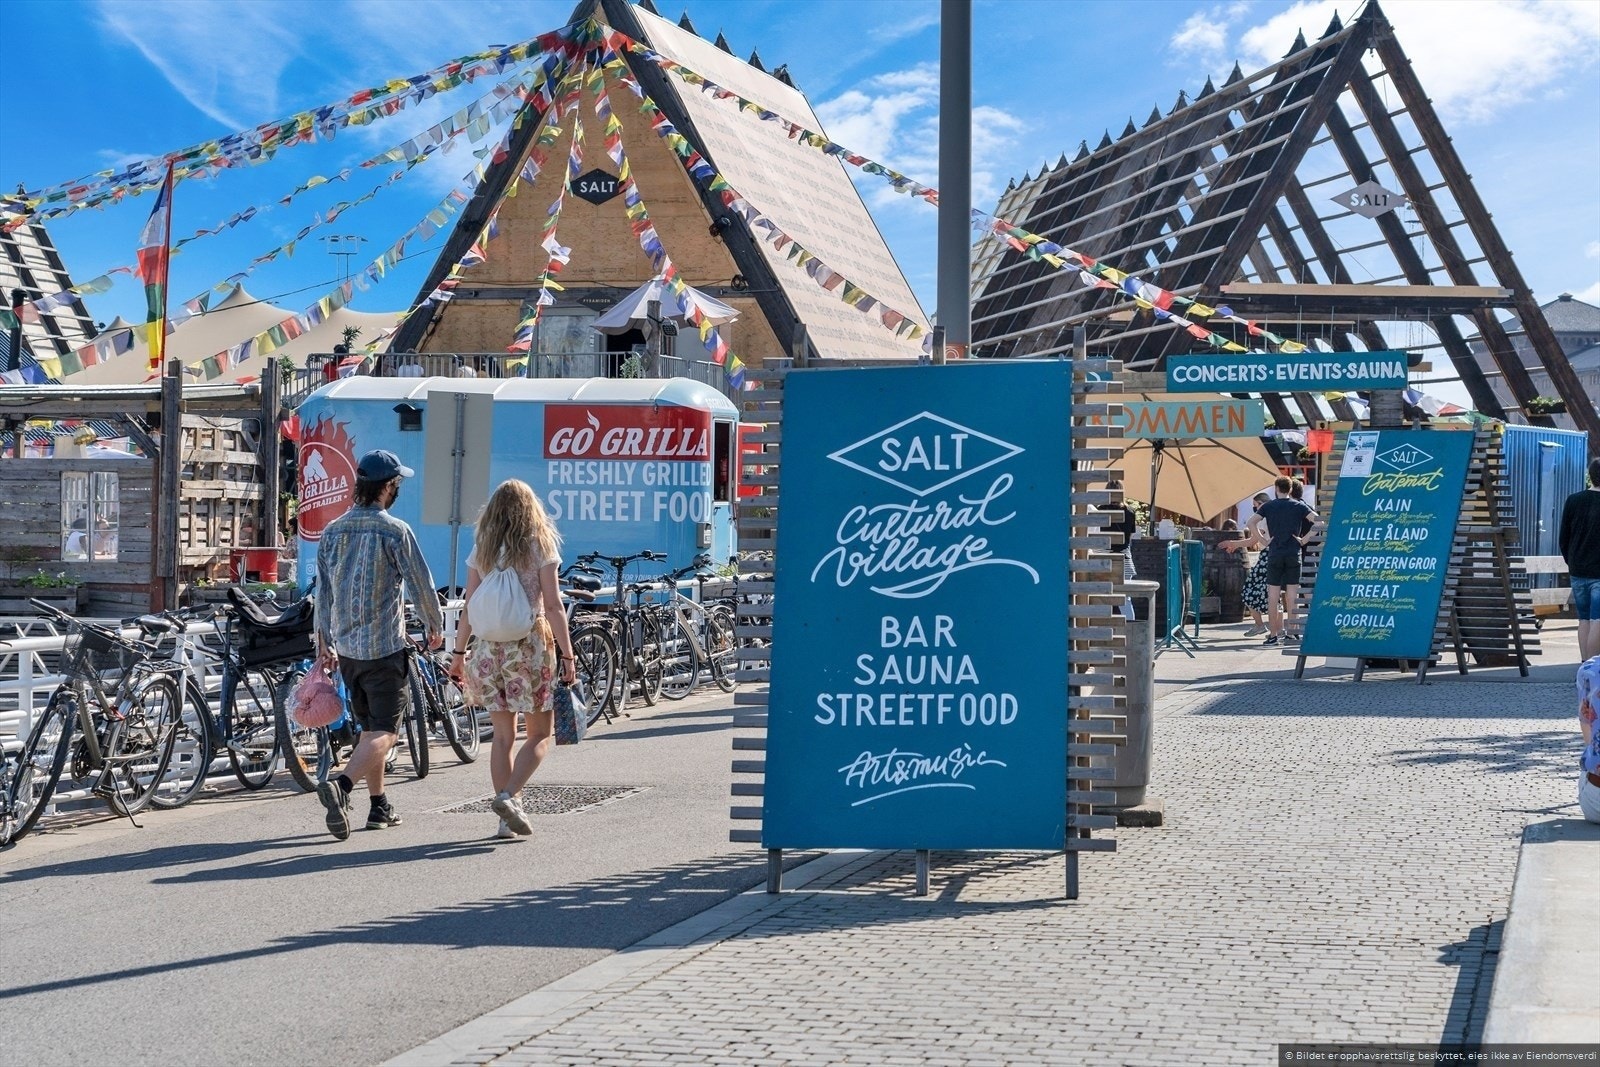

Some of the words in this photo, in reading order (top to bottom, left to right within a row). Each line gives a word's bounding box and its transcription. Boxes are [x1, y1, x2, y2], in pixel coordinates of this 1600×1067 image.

[580, 180, 615, 193] SALT
[1350, 193, 1389, 207] SALT
[549, 426, 596, 456] GO
[600, 426, 708, 457] GRILLA
[878, 433, 968, 472] SALT
[1391, 450, 1418, 464] SALT
[547, 461, 637, 485] FRESHLY
[642, 462, 711, 486] GRILLED
[1362, 467, 1443, 496] Gatemat
[305, 475, 348, 500] GRILLA
[312, 494, 343, 509] TRAILER
[547, 489, 645, 522] STREET
[653, 490, 712, 523] FOOD
[836, 473, 1016, 546] Cultural
[1374, 498, 1412, 512] KAIN
[1348, 527, 1382, 541] LILLE
[1384, 524, 1428, 541] ÅLAND
[1331, 556, 1354, 569] DER
[1350, 585, 1399, 598] TREEAT
[1334, 613, 1395, 628] GOGRILLA
[880, 615, 957, 648] BAR
[854, 654, 980, 686] SAUNA
